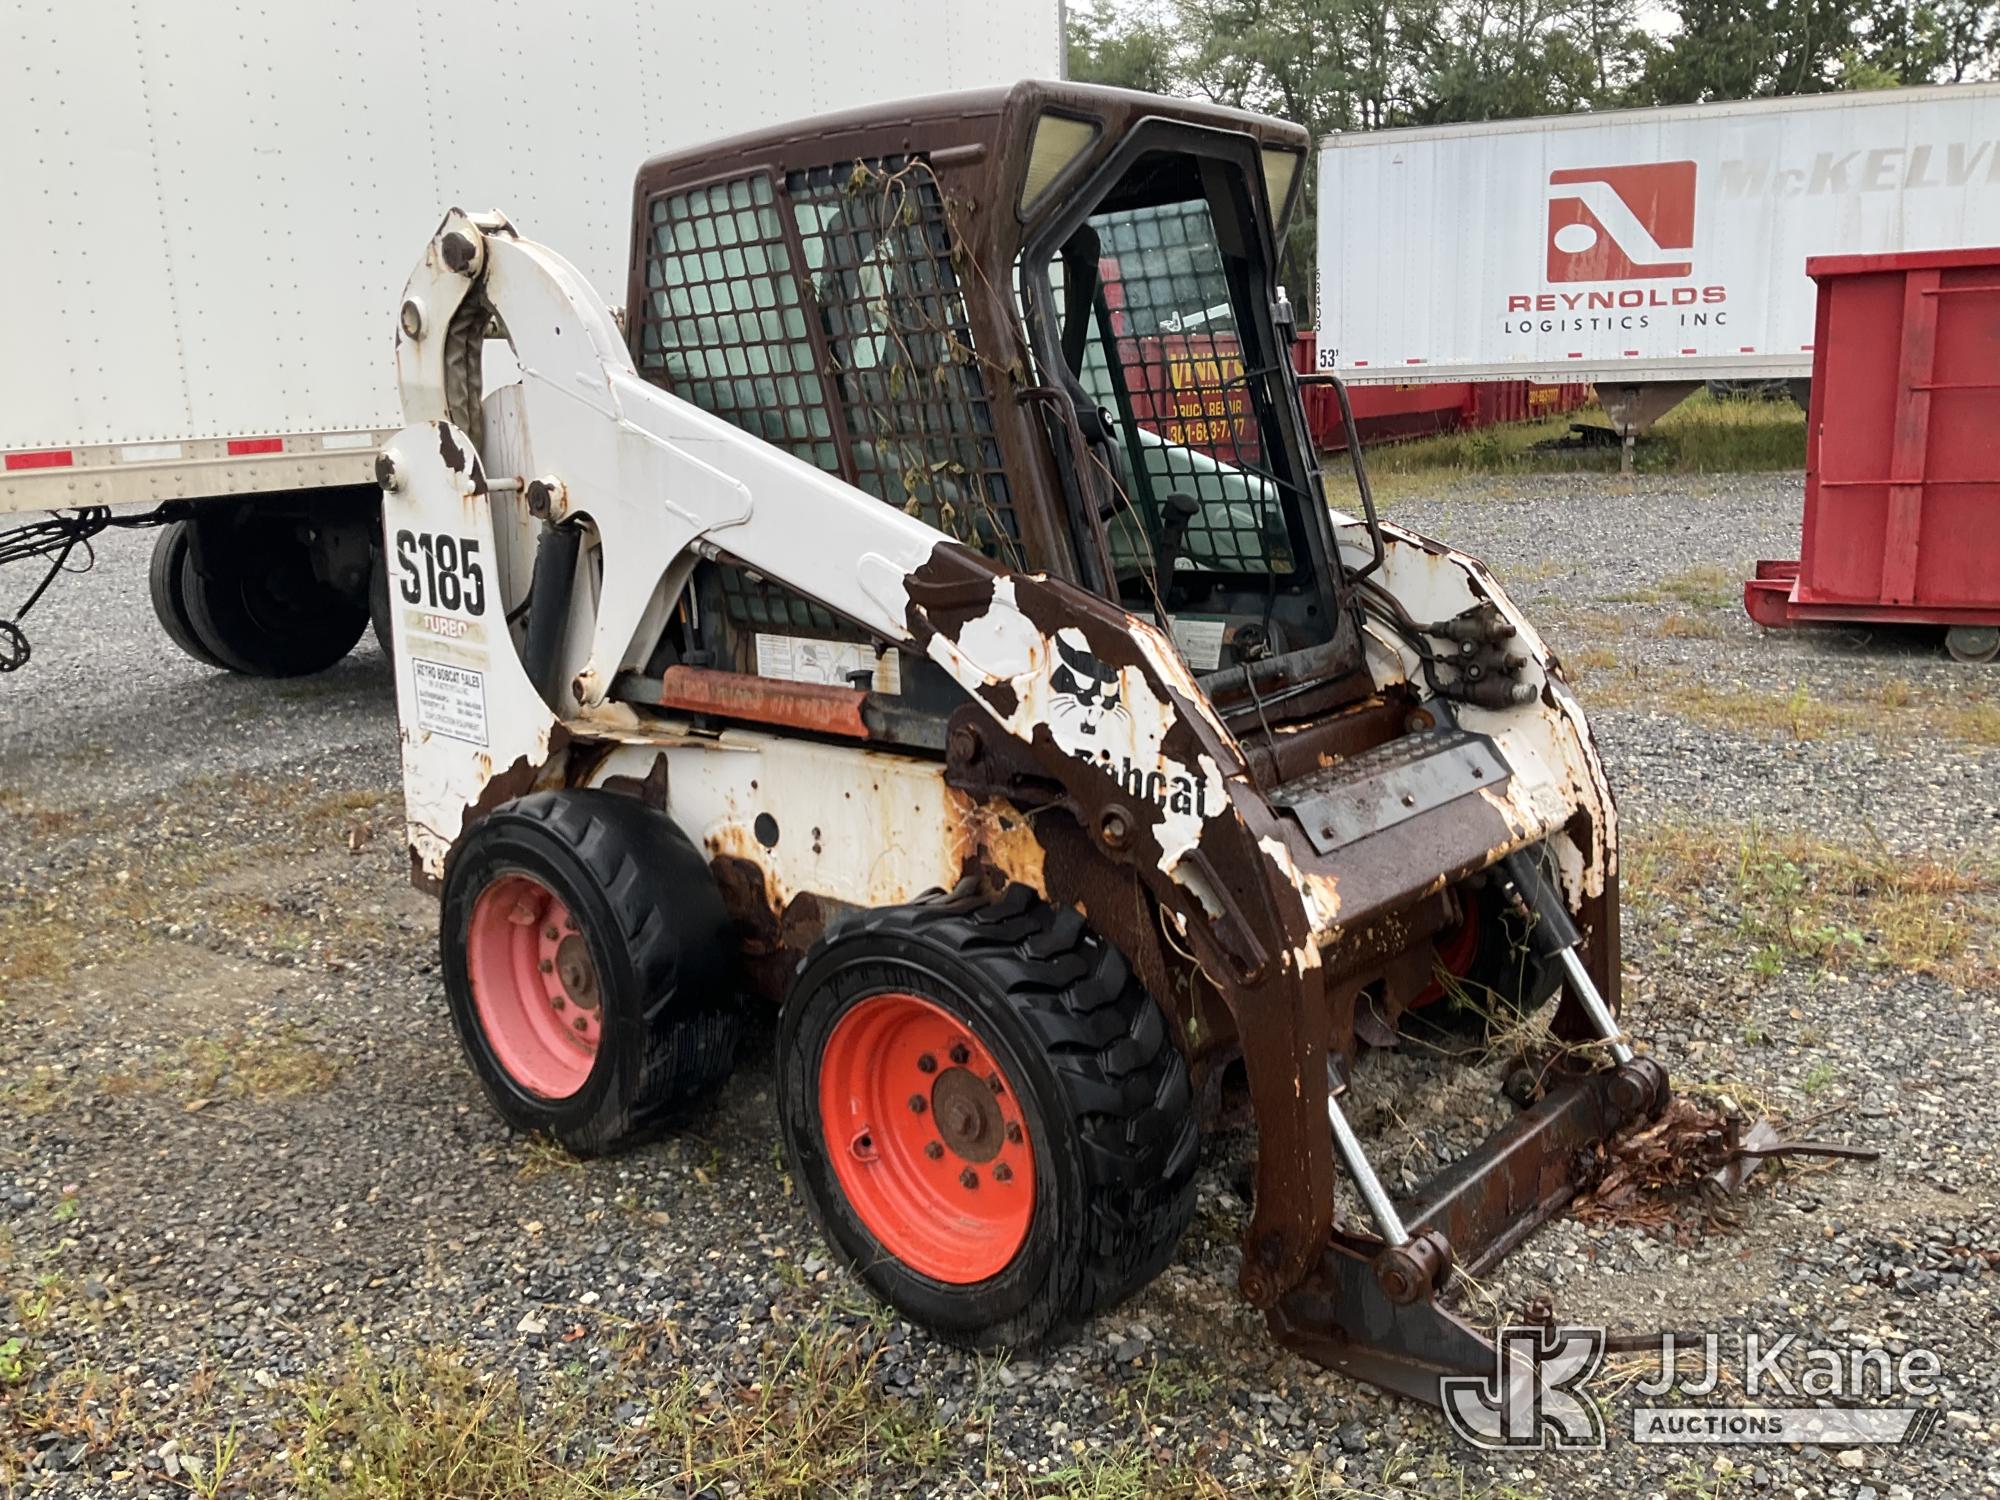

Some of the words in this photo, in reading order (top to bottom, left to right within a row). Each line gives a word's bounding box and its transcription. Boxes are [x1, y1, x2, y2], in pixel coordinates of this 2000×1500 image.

[1508, 286, 1727, 313] REYNOLDS
[1505, 315, 1649, 334] LOGISTICS
[1681, 312, 1727, 326] INC
[1320, 349, 1339, 368] 53'
[396, 529, 485, 617] S185
[424, 614, 468, 638] TURBO
[437, 667, 460, 684] BOBCAT
